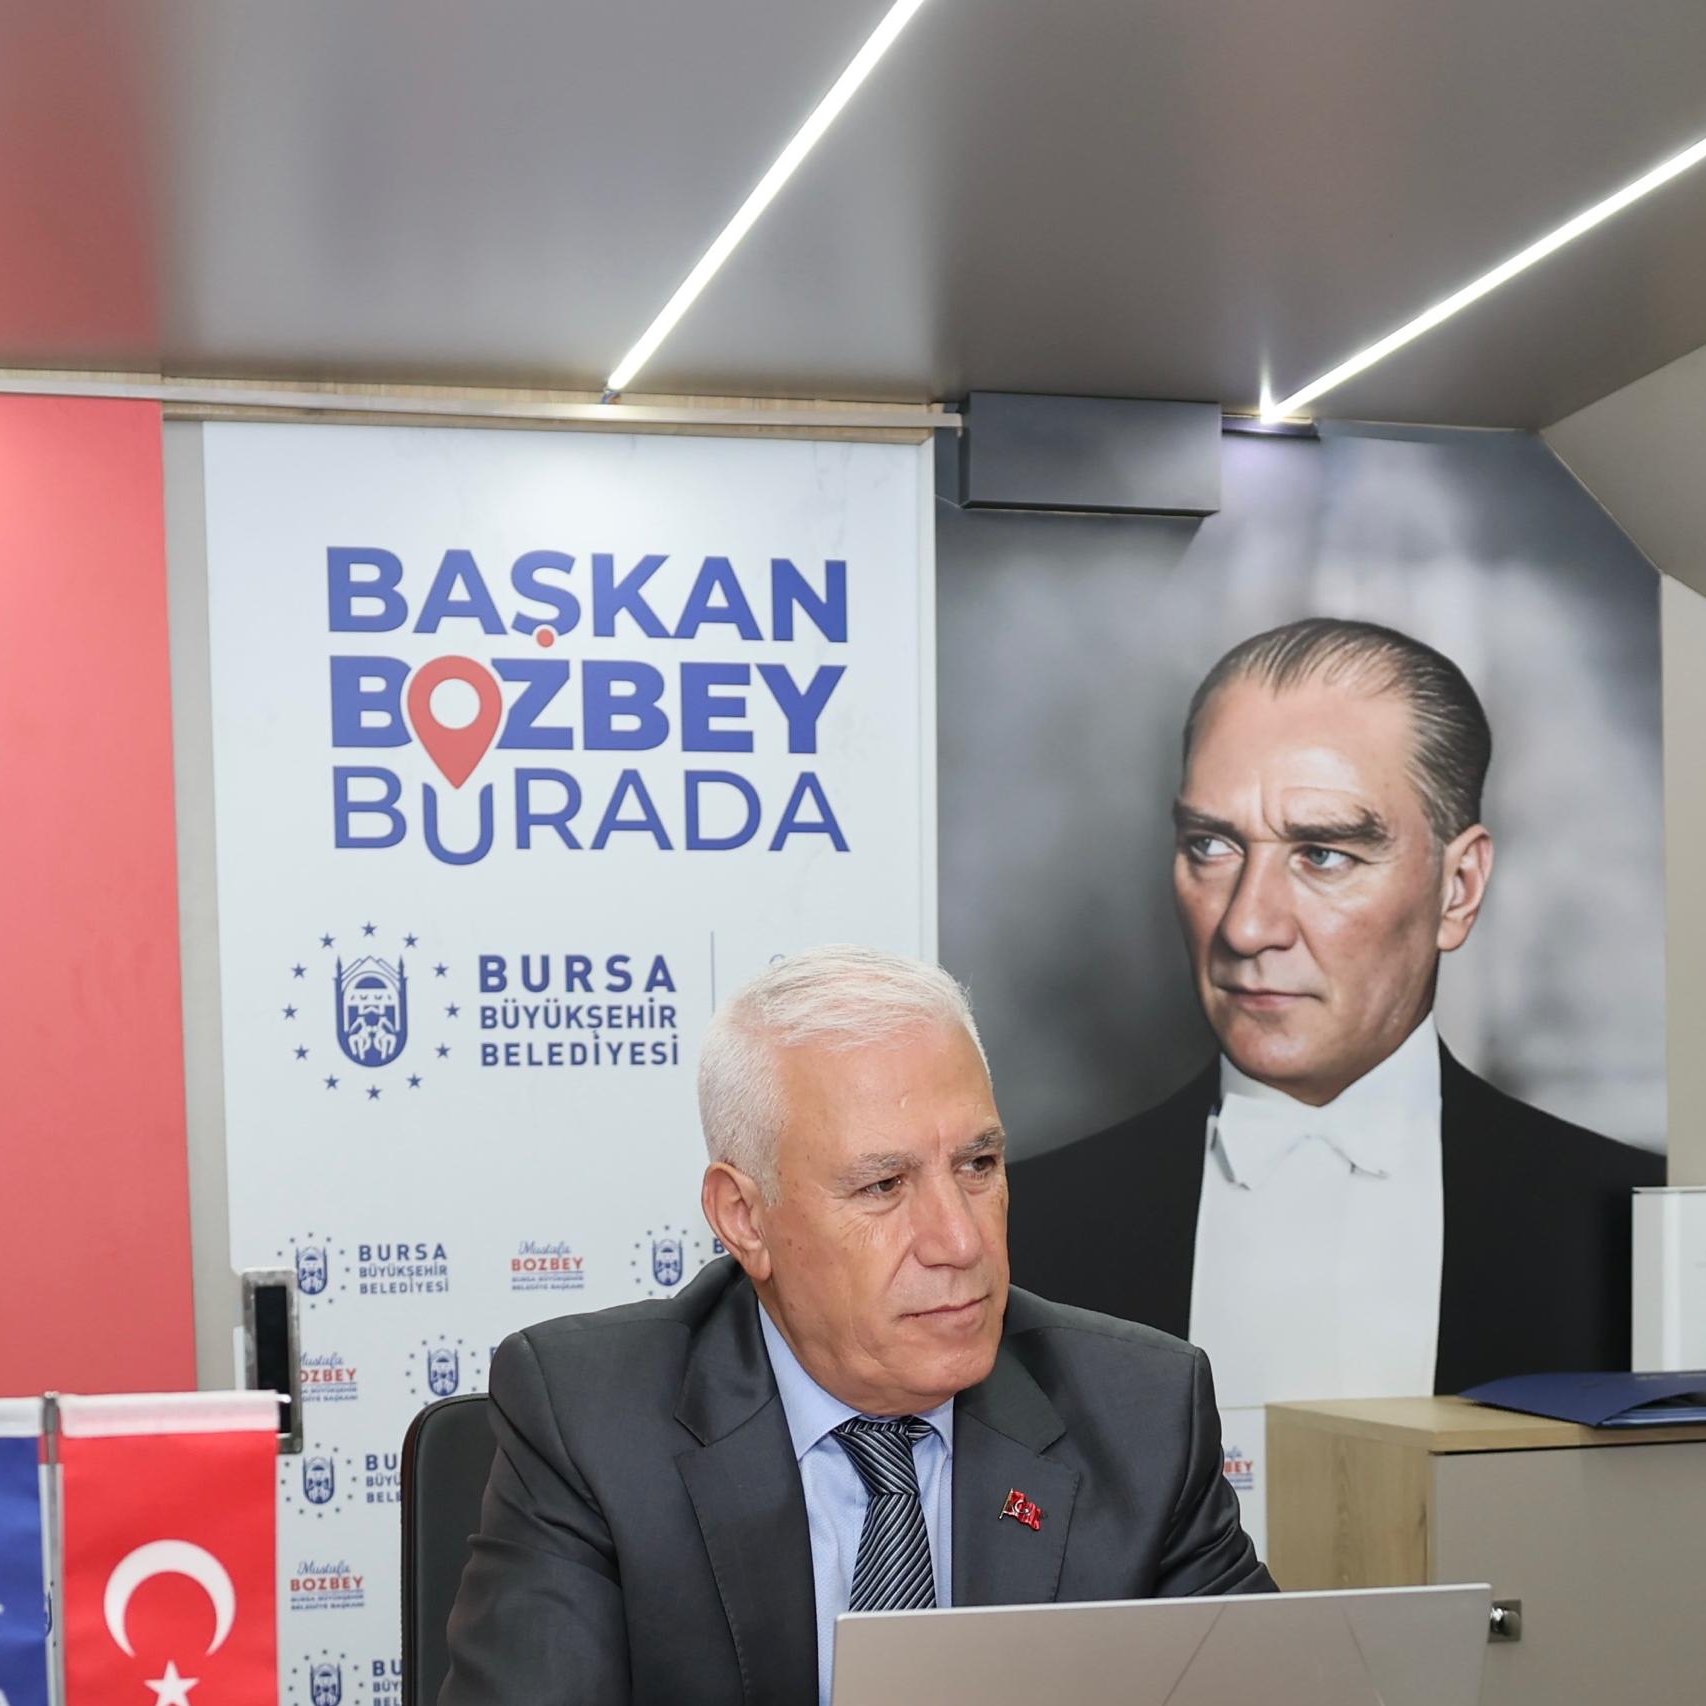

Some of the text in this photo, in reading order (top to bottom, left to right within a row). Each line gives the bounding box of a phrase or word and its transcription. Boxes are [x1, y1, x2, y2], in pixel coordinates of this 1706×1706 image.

[326, 546, 849, 648] BAŞKAN
[329, 655, 849, 789] BOZBEY
[332, 766, 851, 866] BURADA
[478, 954, 678, 994] BURSA
[479, 995, 678, 1036] BÜYÜKŞEHİR
[480, 1034, 680, 1068] BELEDİYESİ
[359, 1243, 448, 1262] BURSA
[358, 1262, 448, 1279] BÜYÜKŞEHİR
[512, 1258, 583, 1272] BOZBEY
[359, 1277, 450, 1295] BELEDİYESİ
[300, 1369, 356, 1383] OZBEY
[297, 1560, 351, 1576] Mustafa
[291, 1576, 363, 1591] BOZBEY
